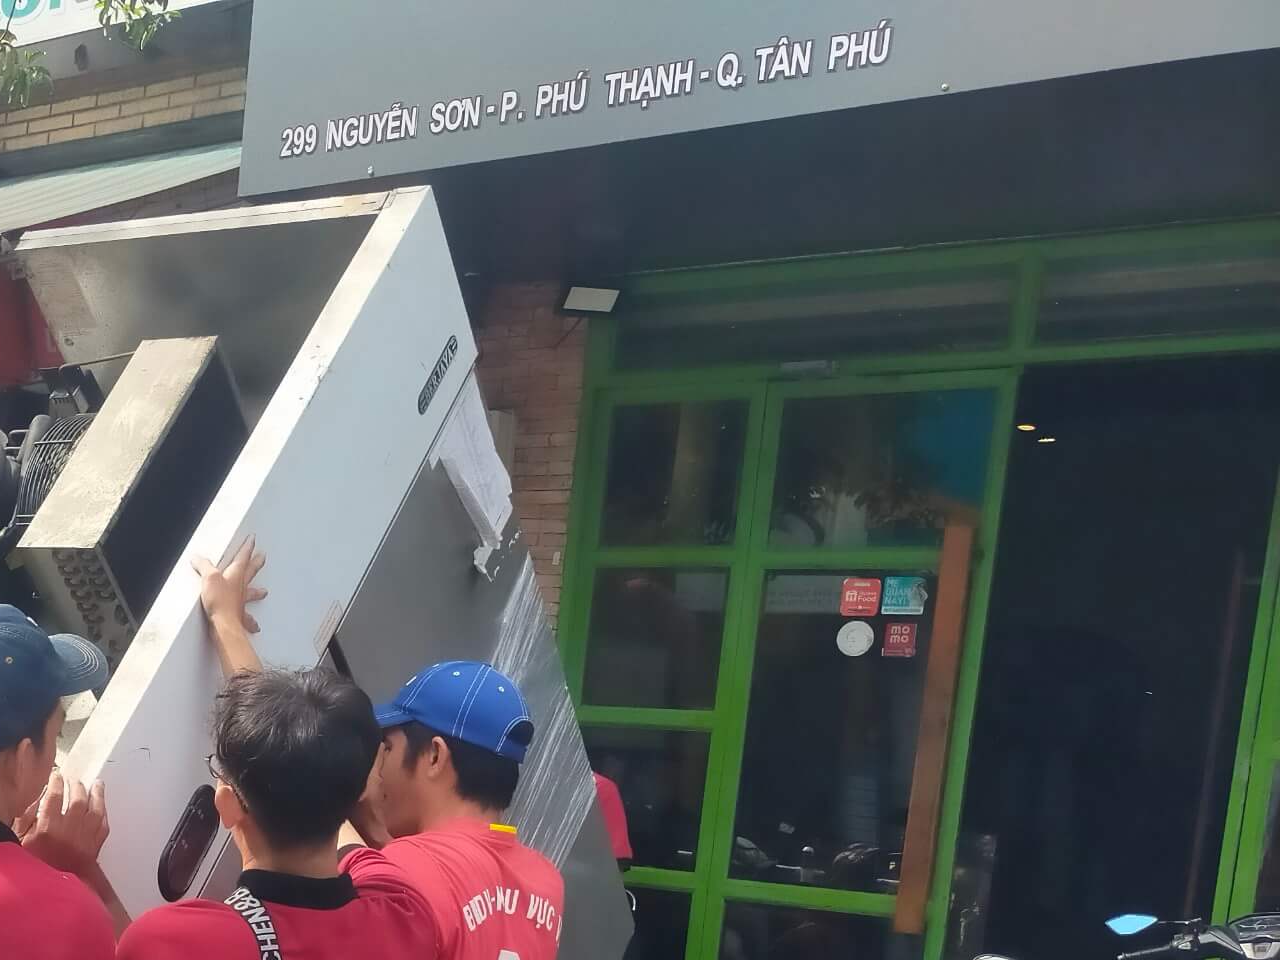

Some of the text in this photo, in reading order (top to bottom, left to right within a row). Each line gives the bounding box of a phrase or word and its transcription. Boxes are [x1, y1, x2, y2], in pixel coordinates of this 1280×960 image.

[280, 127, 317, 158] 299
[325, 102, 417, 151] NGUYỄN
[429, 96, 481, 133] SƠN
[500, 91, 524, 123] P.
[535, 71, 588, 117] PHÚ
[605, 60, 693, 112] THẠNH
[716, 51, 743, 90] Q.
[754, 37, 812, 82] TÂN
[827, 20, 892, 71] PHÚ
